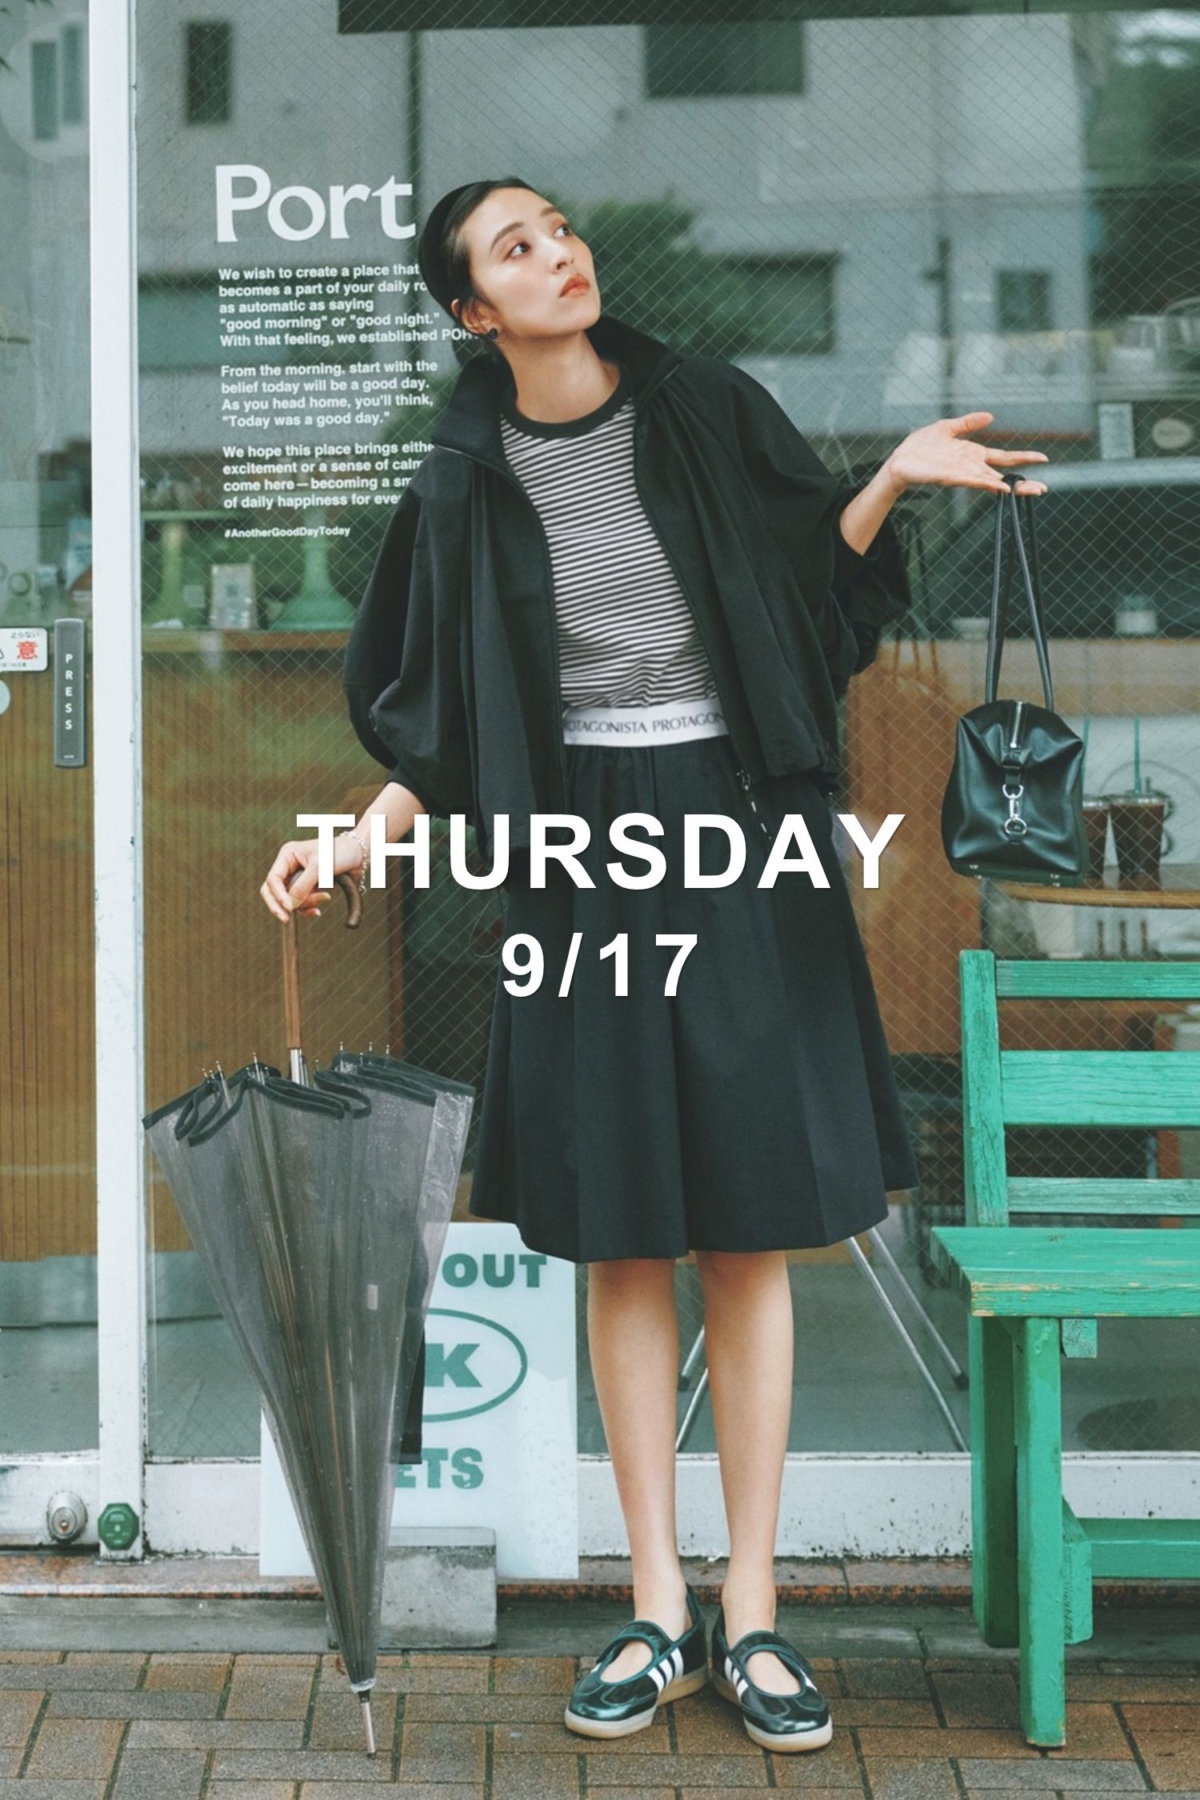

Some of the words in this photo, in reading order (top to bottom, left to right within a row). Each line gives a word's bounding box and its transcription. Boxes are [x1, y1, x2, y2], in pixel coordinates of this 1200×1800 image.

[216, 164, 416, 242] Port
[219, 269, 240, 280] We
[243, 267, 274, 279] wish
[278, 267, 292, 278] to
[296, 266, 338, 278] create
[341, 267, 350, 277] a
[353, 264, 389, 279] place
[393, 263, 420, 275] that
[219, 285, 280, 297] becomes
[283, 286, 292, 296] a
[296, 283, 323, 300] part
[327, 282, 340, 294] of
[343, 284, 374, 298] your
[378, 281, 410, 295] daily
[219, 303, 235, 314] as
[239, 300, 305, 313] automatic
[309, 301, 325, 312] as
[329, 299, 374, 313] saying
[221, 318, 261, 333] "good
[265, 316, 327, 330] morning"
[332, 317, 346, 327] or
[350, 315, 390, 329] "good
[395, 313, 440, 327] night."
[220, 334, 250, 346] With
[254, 333, 280, 346] that
[284, 332, 334, 347] feeling,
[337, 334, 356, 344] we
[360, 329, 437, 343] established
[221, 365, 256, 377] From
[260, 364, 281, 376] the
[285, 363, 346, 378] morning,
[350, 363, 380, 374] start
[384, 361, 413, 373] with
[416, 360, 438, 372] the
[221, 381, 258, 394] belief
[262, 380, 299, 394] today
[304, 380, 327, 391] will
[330, 379, 347, 390] be
[351, 381, 359, 390] a
[362, 378, 397, 393] good
[401, 377, 429, 391] day.
[222, 399, 240, 411] As
[244, 400, 269, 413] you
[273, 397, 306, 409] head
[310, 397, 351, 410] home,
[355, 394, 392, 408] you'll
[396, 395, 434, 407] think,
[222, 415, 270, 429] "Today
[274, 416, 300, 426] was
[305, 415, 313, 425] a
[316, 413, 351, 427] good
[355, 412, 390, 426] day."
[223, 446, 244, 458] We
[248, 446, 281, 459] hope
[285, 444, 311, 456] this
[315, 443, 351, 458] place
[355, 442, 398, 455] brings
[223, 462, 297, 475] excitement
[301, 463, 316, 473] or
[320, 462, 327, 472] a
[331, 461, 371, 472] sense
[375, 459, 389, 471] of
[223, 481, 261, 492] come
[382, 478, 390, 487] a
[224, 497, 238, 509] of
[241, 495, 274, 510] daily
[278, 494, 348, 509] happiness
[352, 493, 370, 505] for
[225, 527, 350, 538] #AnotherGoodDayToday
[65, 653, 74, 730] PRESS
[442, 1253, 547, 1288] OUT
